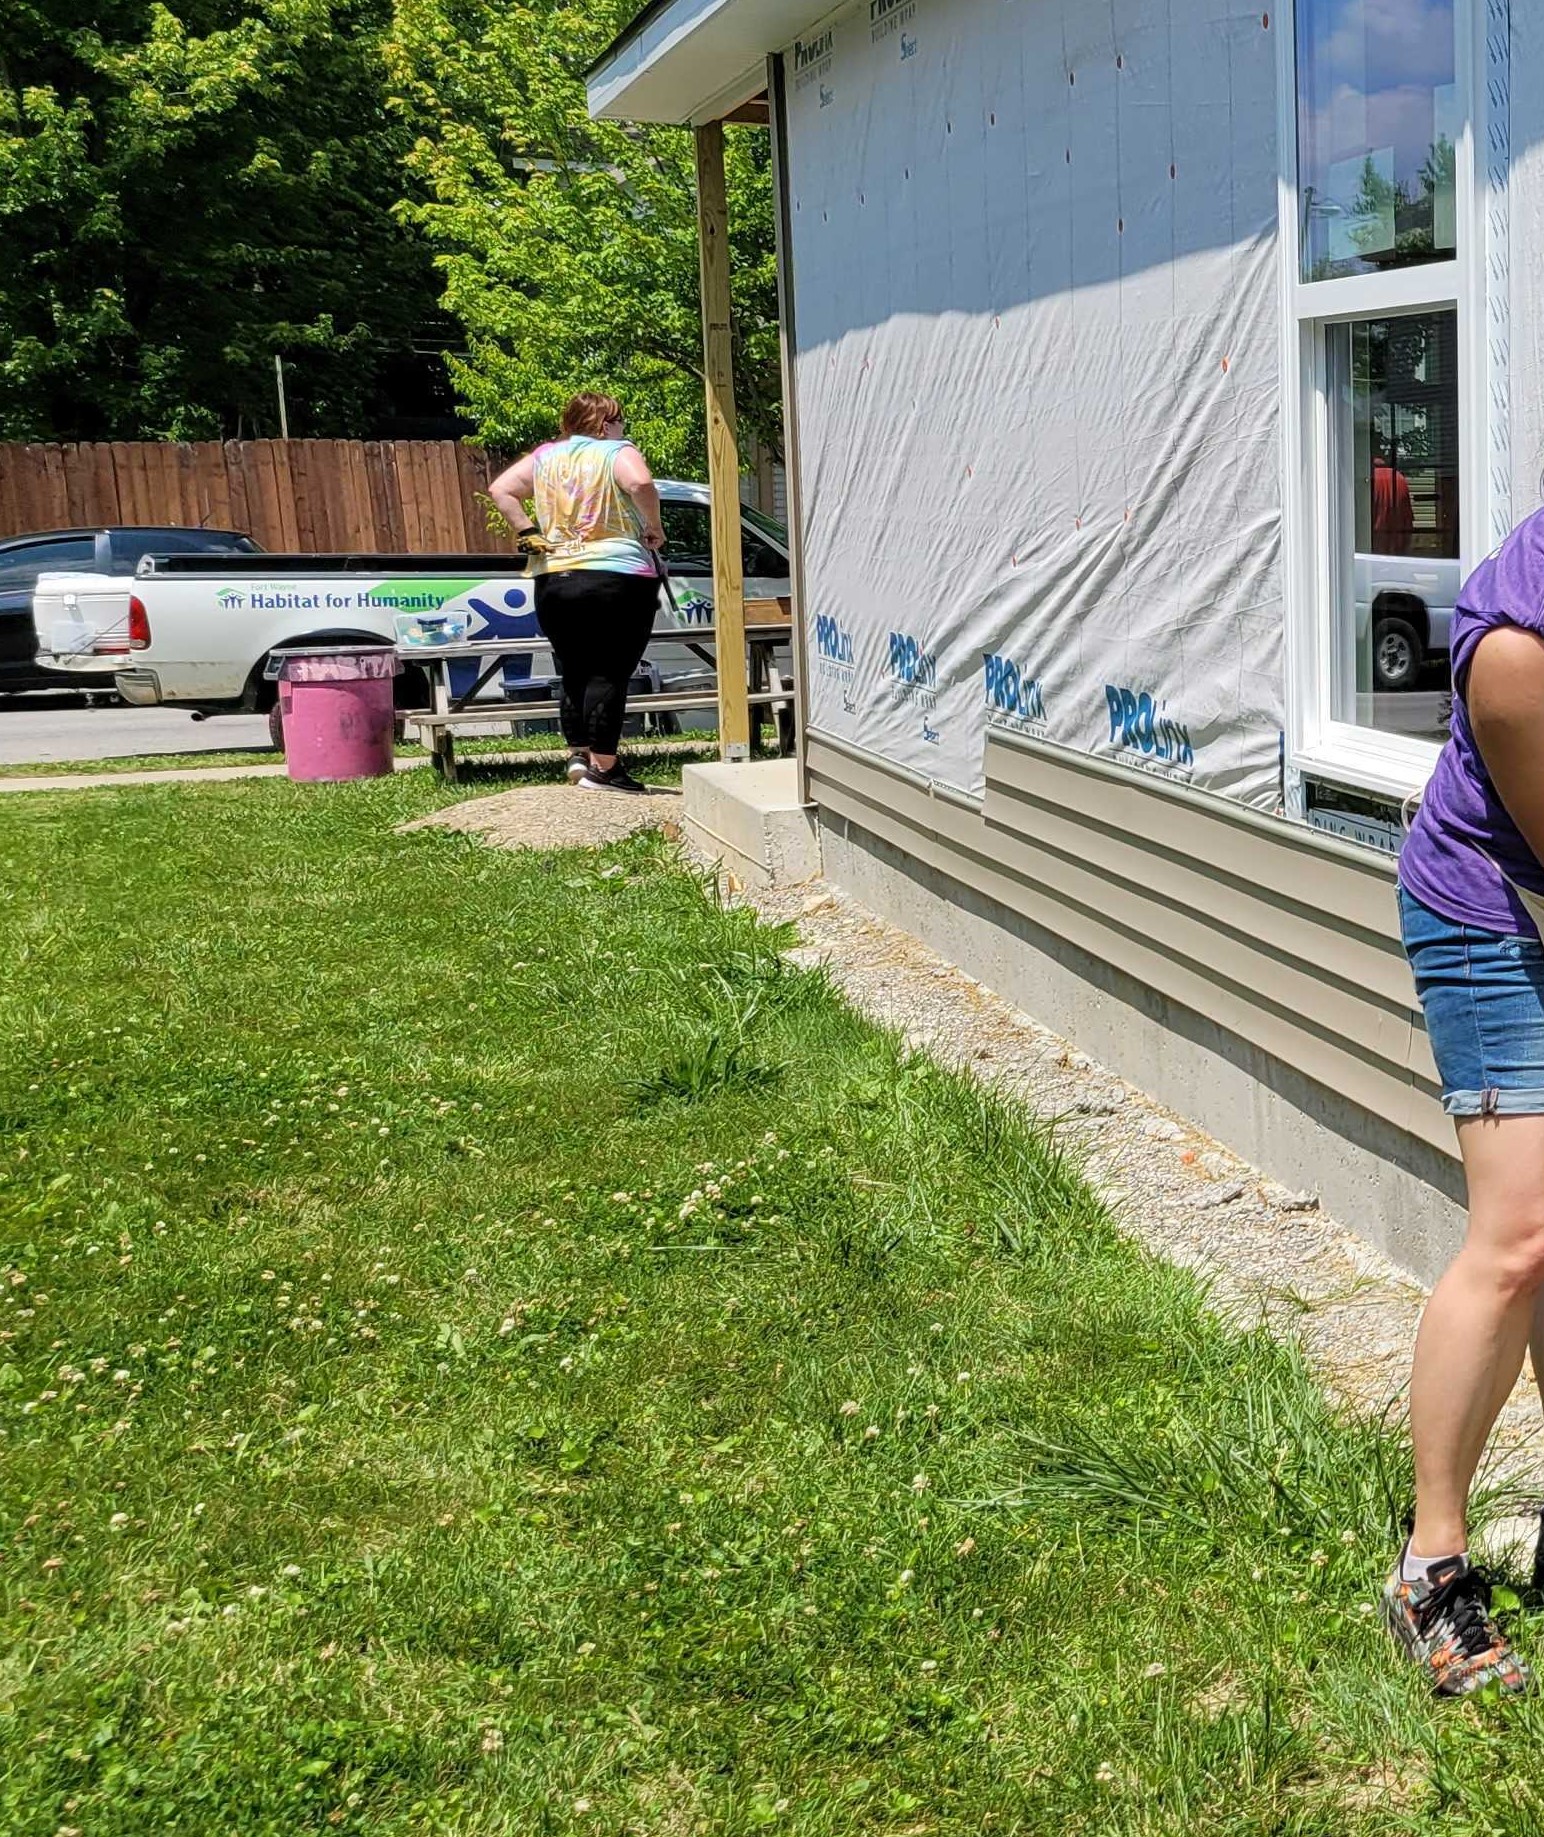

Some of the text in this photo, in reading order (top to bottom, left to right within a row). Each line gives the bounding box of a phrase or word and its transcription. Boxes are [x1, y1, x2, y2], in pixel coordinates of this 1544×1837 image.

[251, 592, 445, 610] Habitat for Humanity
